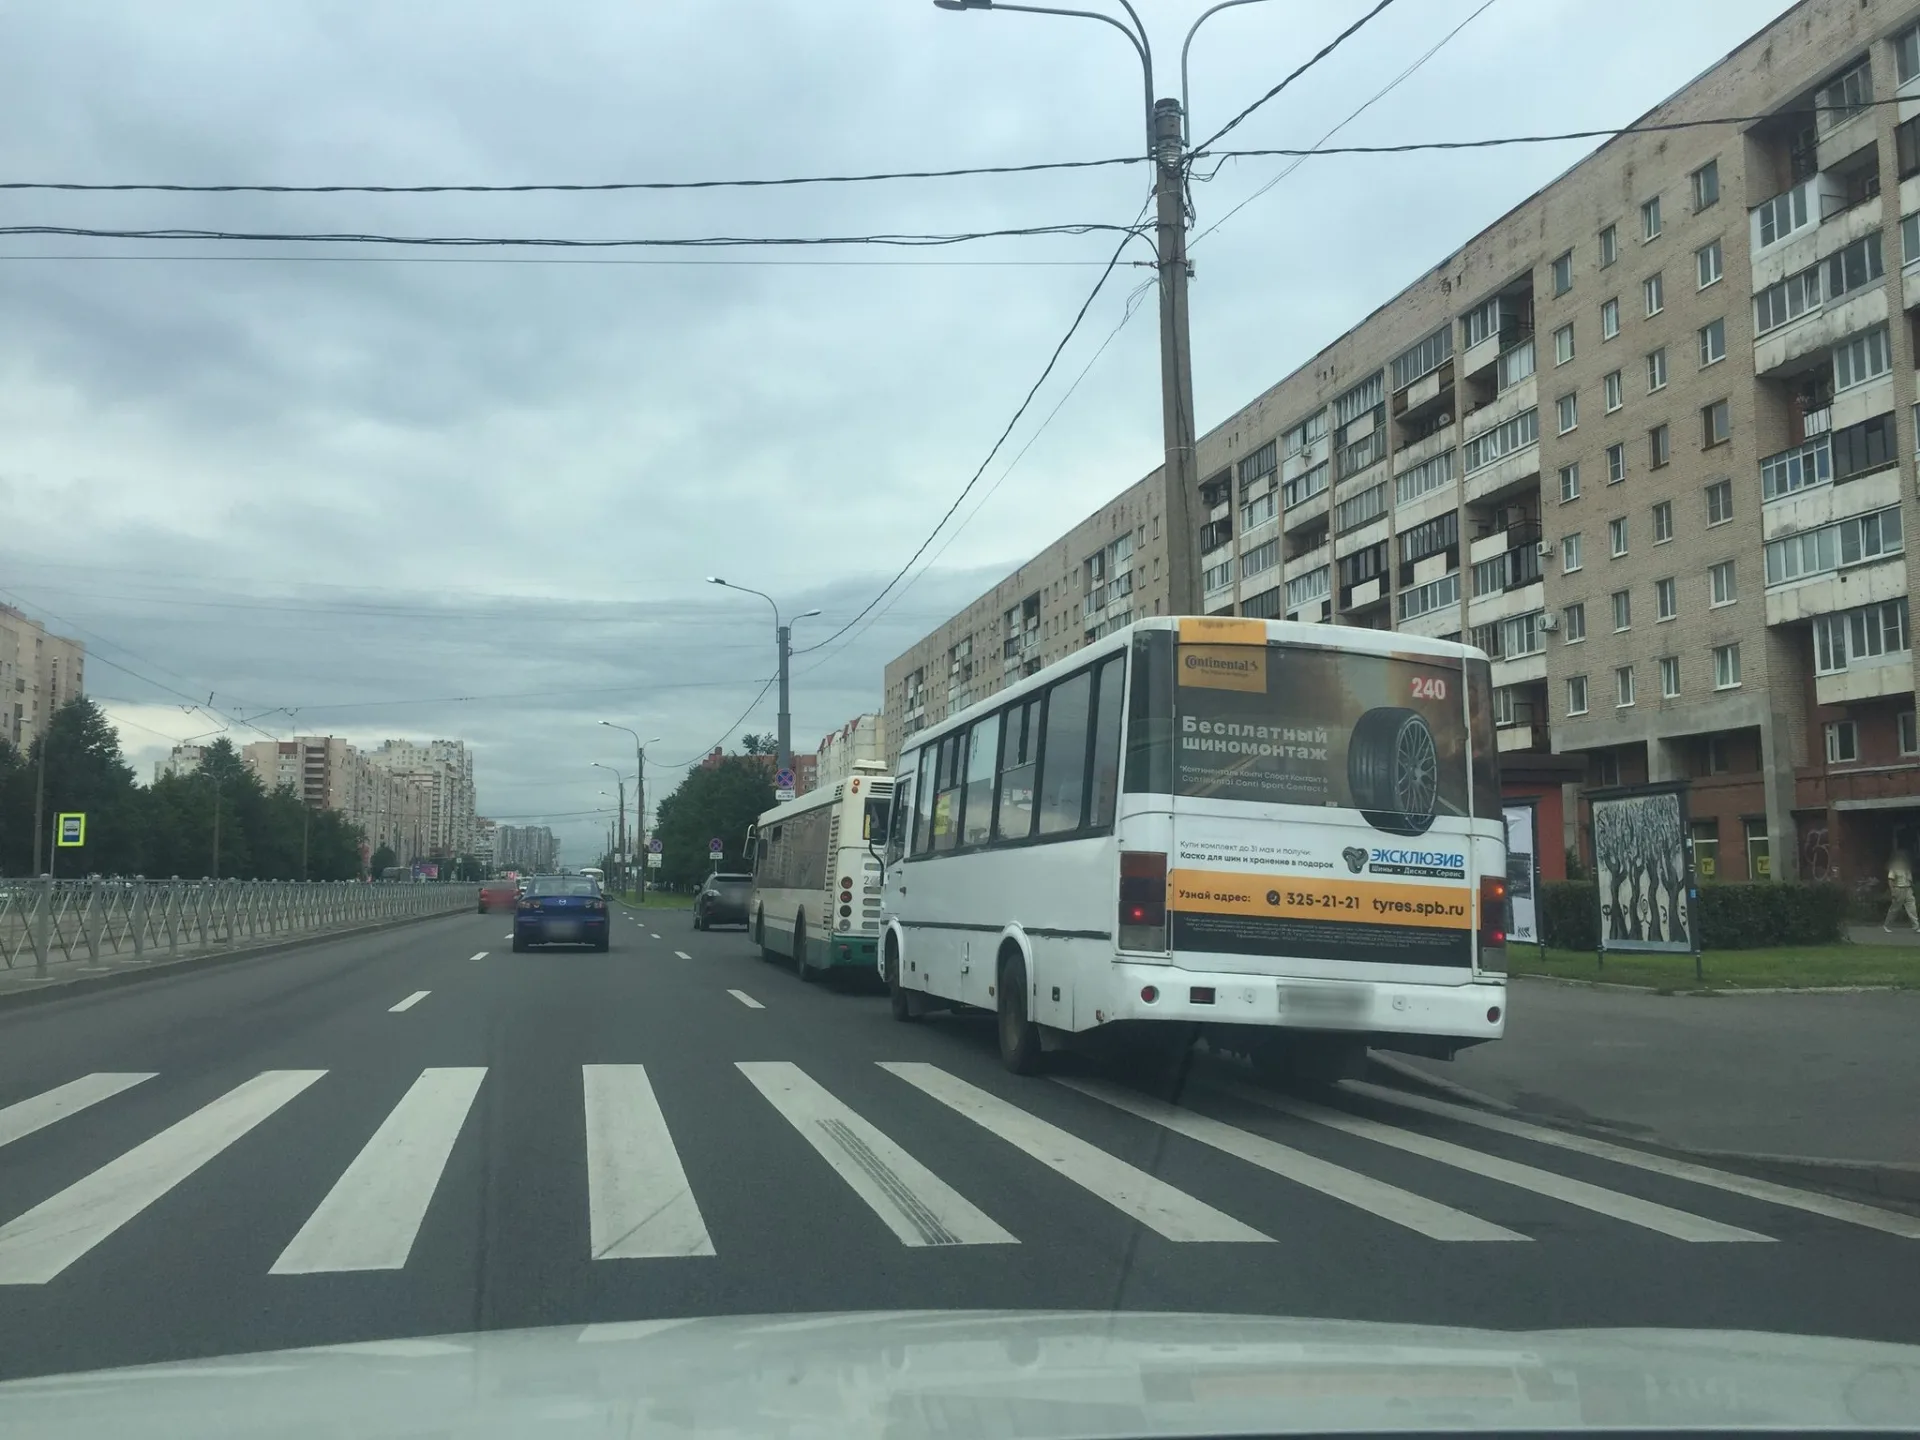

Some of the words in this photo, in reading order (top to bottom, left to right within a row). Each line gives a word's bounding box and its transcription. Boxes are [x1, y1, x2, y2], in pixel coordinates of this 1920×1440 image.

[1185, 654, 1248, 671] Continental
[1411, 677, 1446, 700] 240
[1182, 715, 1328, 743] Бесплатный
[1182, 737, 1328, 760] шиномонтаж
[1235, 779, 1259, 787] Conti
[1180, 840, 1199, 849] Купи
[1201, 843, 1238, 851] комплект
[1180, 851, 1206, 860] Каско
[1249, 857, 1290, 865] хранение
[1298, 860, 1334, 869] подарок
[1370, 848, 1465, 868] ЭКСКЛЮЗИВ
[1371, 864, 1393, 873] Шины
[1403, 867, 1427, 876] Диски
[1436, 869, 1462, 878] Сервис
[1179, 889, 1211, 900] Узнай
[1213, 892, 1251, 903] адрес:
[1287, 892, 1360, 909] 325-21-21
[1372, 898, 1464, 916] tyres.spb.ru
